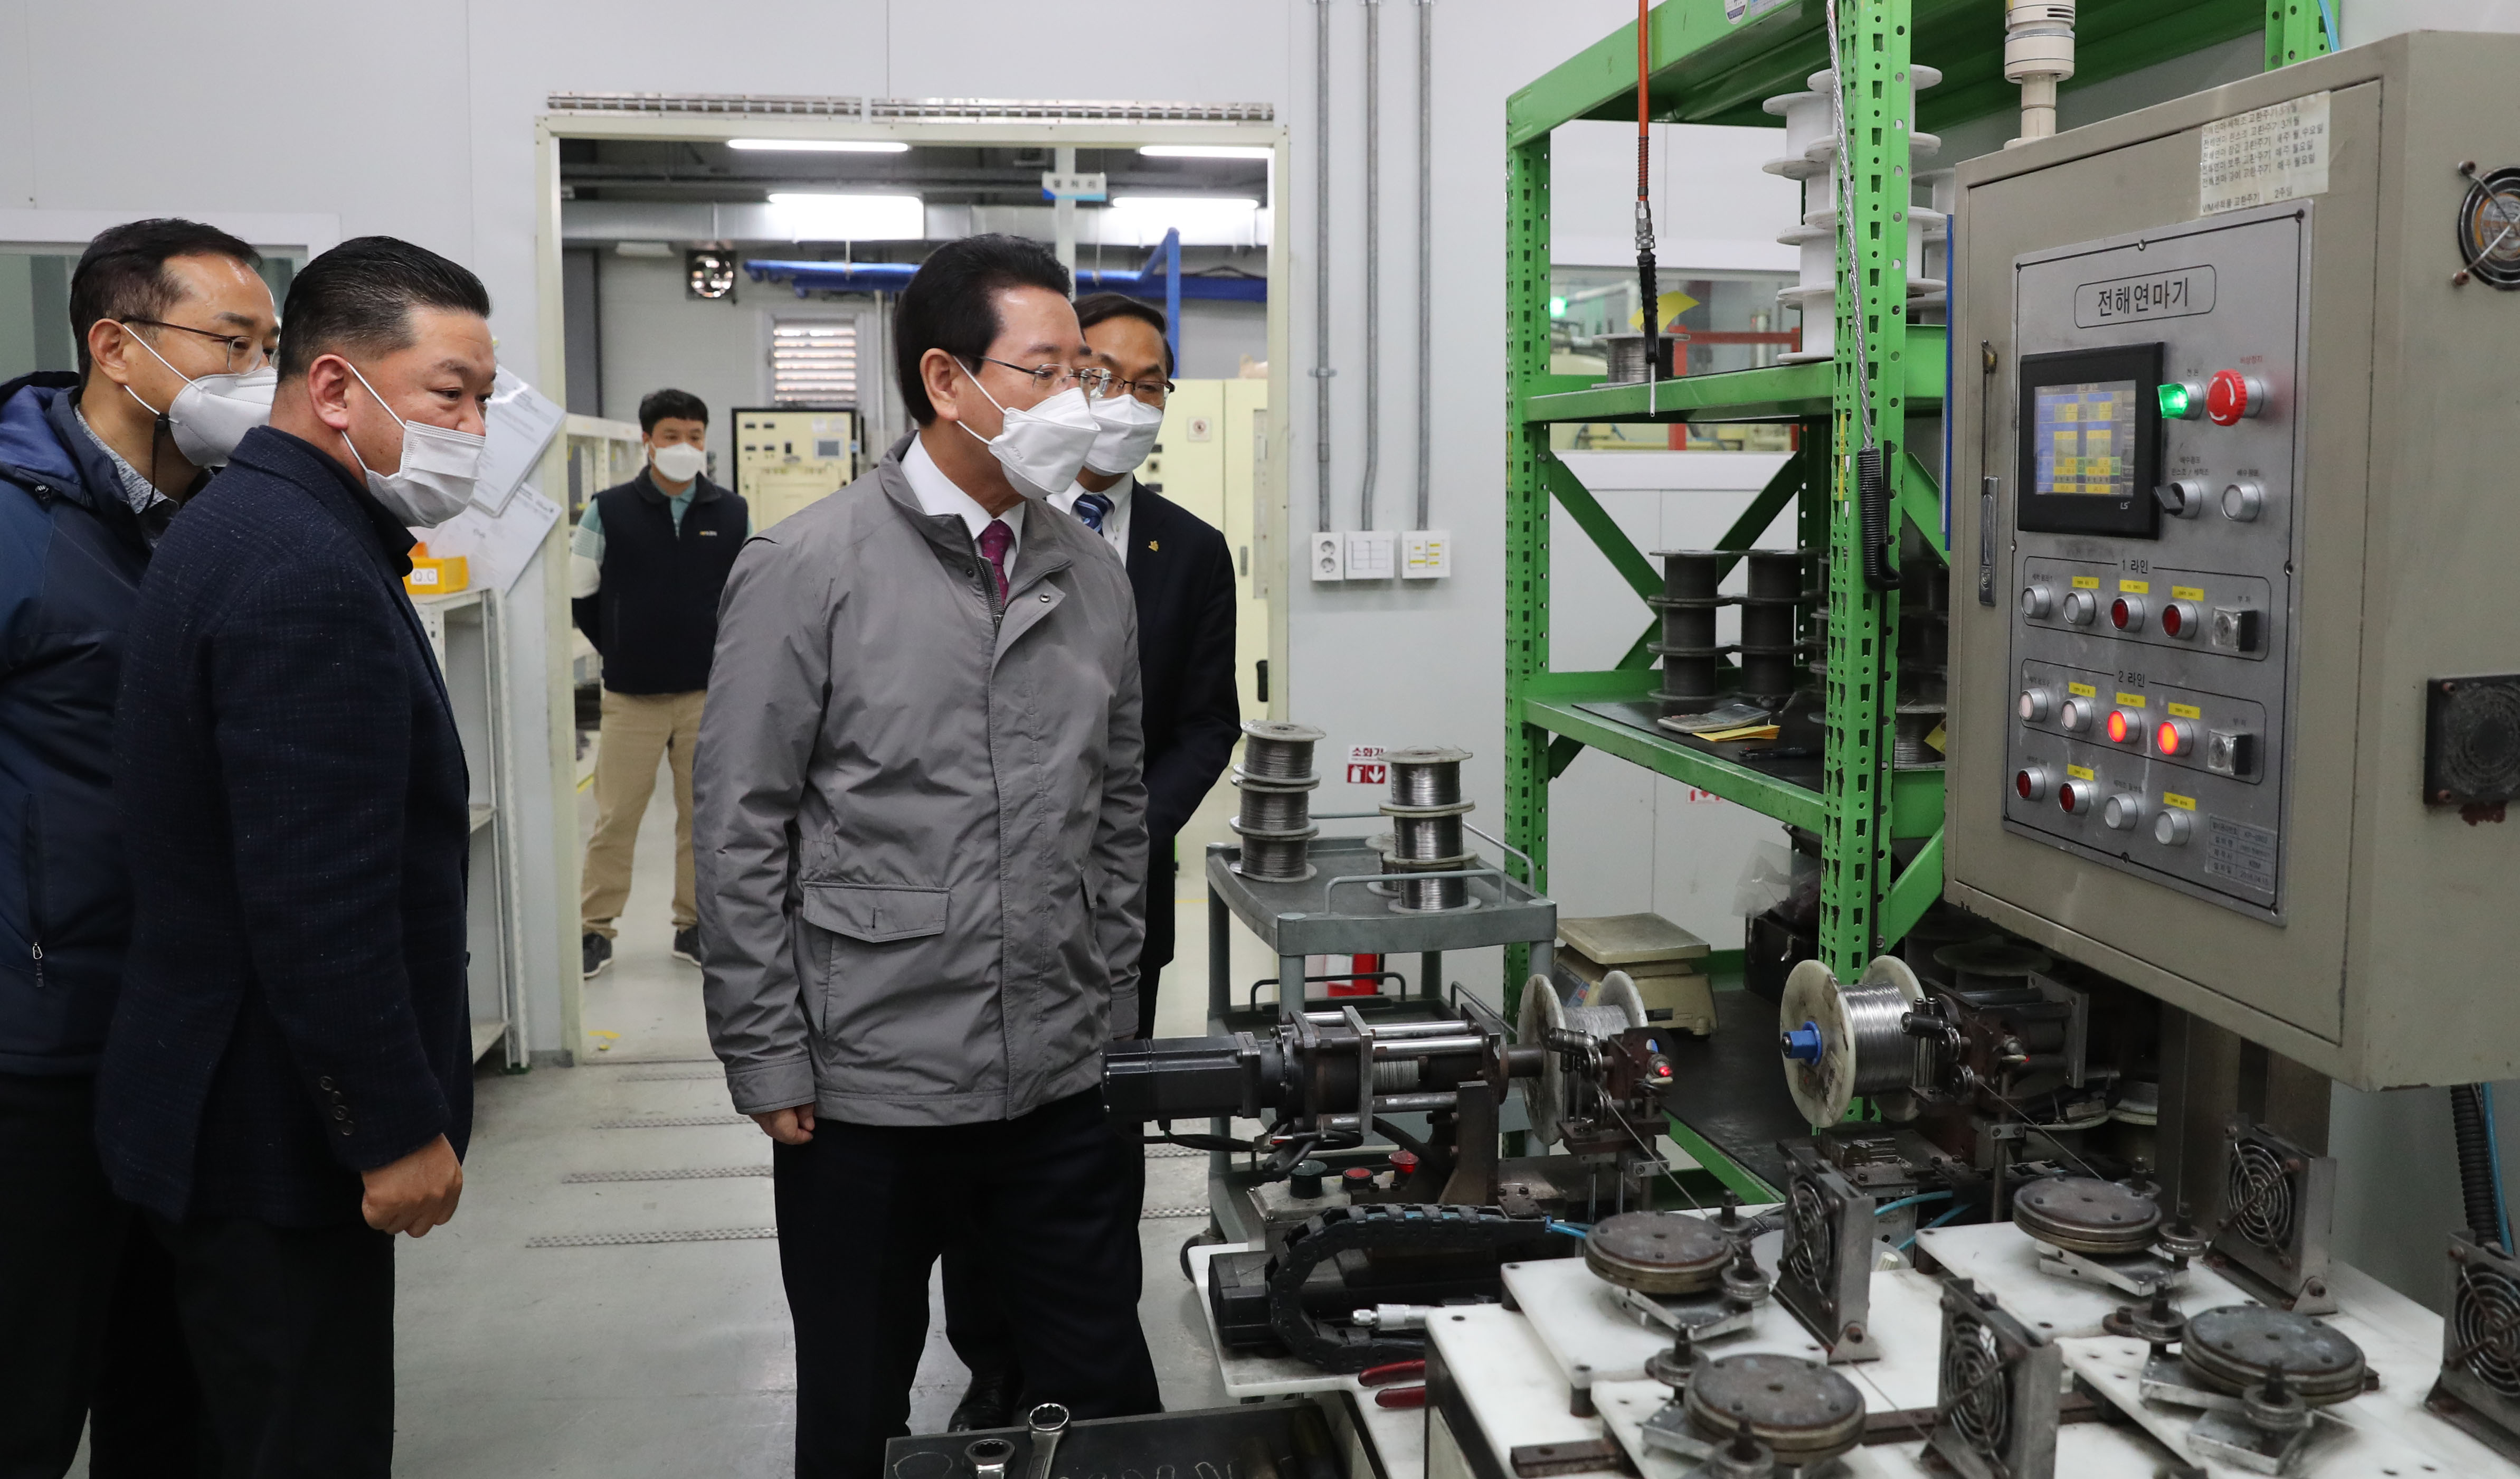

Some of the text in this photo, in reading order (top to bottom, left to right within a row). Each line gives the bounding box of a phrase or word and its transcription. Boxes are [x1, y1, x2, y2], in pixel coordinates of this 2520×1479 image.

[2098, 277, 2189, 317] 전해연마기
[2121, 559, 2148, 574] 1 라인
[2118, 671, 2145, 687] 2 라인
